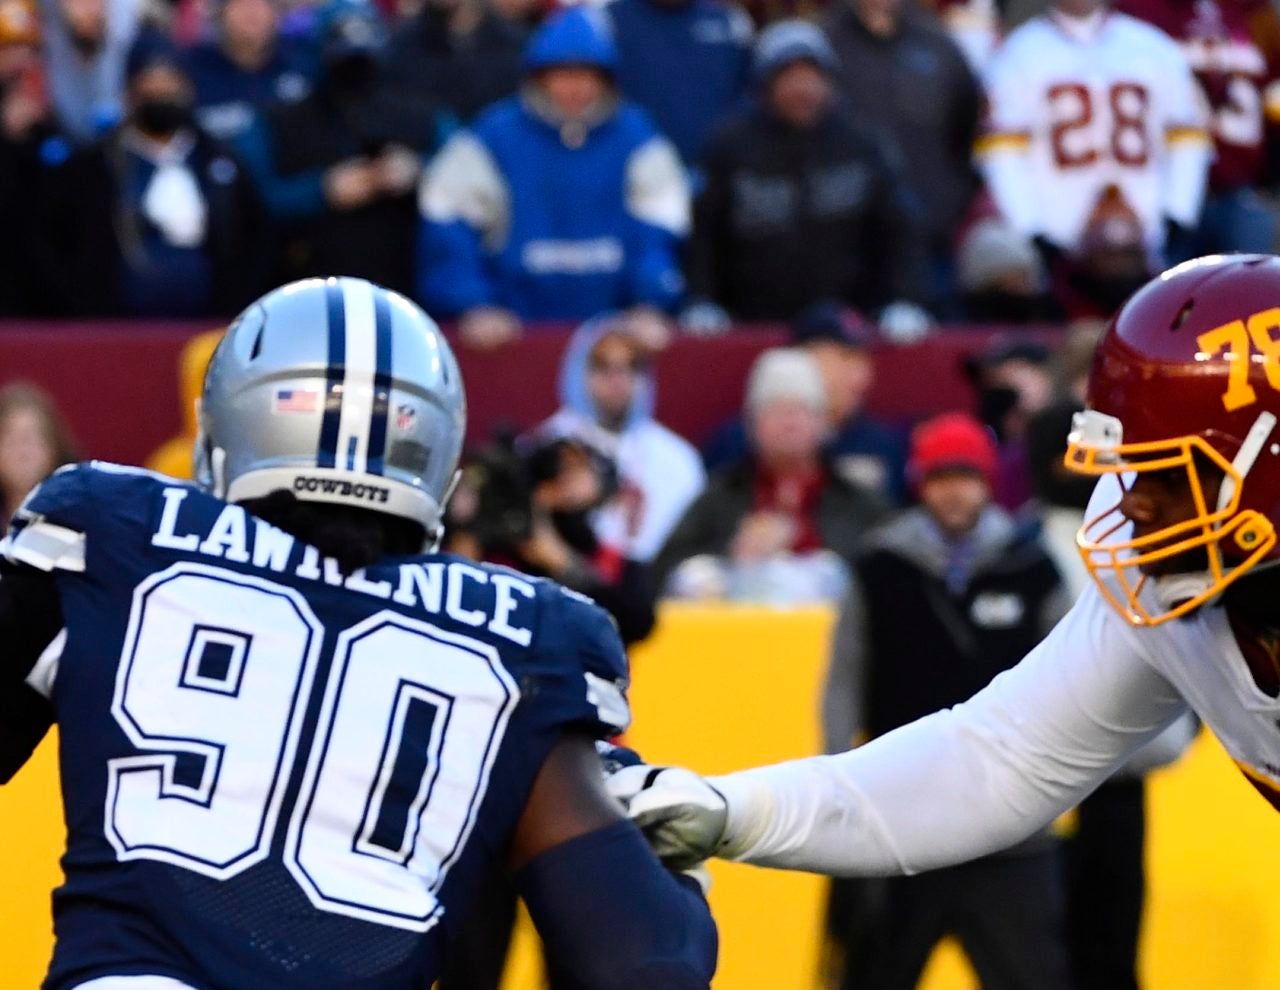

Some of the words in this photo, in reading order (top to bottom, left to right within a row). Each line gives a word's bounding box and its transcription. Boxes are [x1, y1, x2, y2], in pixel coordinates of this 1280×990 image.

[1047, 82, 1149, 168] 28
[293, 475, 389, 503] COWBOYS
[104, 560, 520, 933] 90
